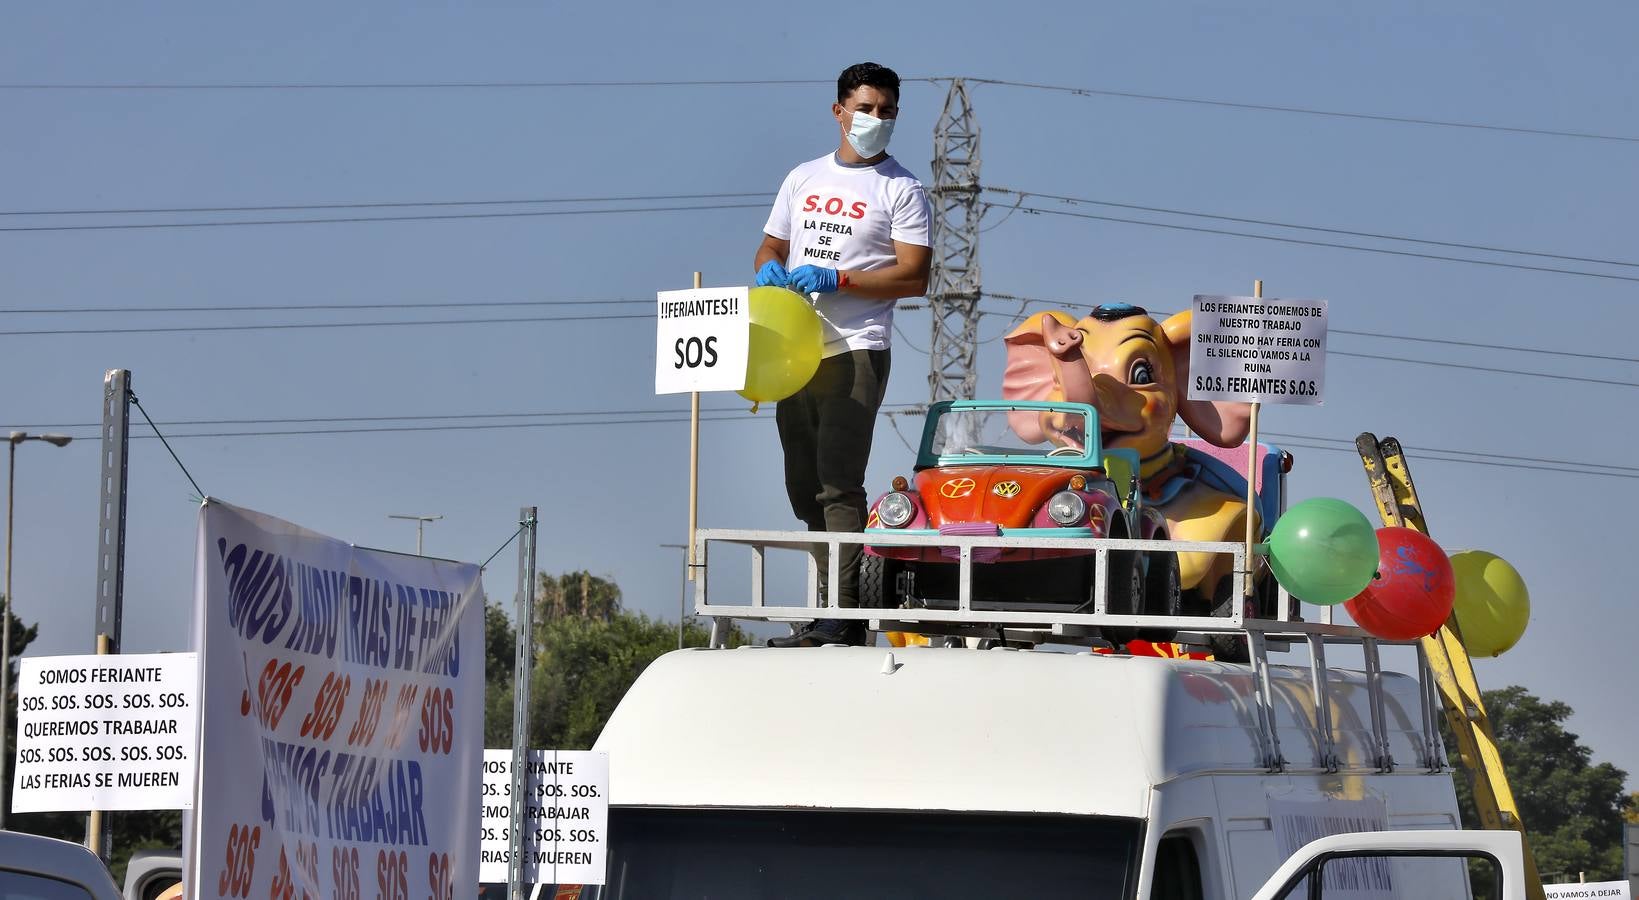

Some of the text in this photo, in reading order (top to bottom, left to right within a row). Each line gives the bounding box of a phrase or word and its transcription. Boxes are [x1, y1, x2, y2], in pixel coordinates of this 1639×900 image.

[802, 194, 867, 219] S.O.S
[804, 220, 853, 236] LA FERIA
[818, 236, 832, 246] SE
[804, 248, 841, 261] MUERE
[661, 297, 738, 318] !!FERIANTES!!
[1200, 303, 1322, 317] LOS FERIANTES COMEMOS DE
[1220, 318, 1301, 331] NUESTRO TRABAJO
[1198, 334, 1320, 348] SIN RUIDO NO HAY FERIA CON
[674, 336, 718, 369] SOS
[1207, 348, 1311, 361] EL SILENCIO VAMOS A LA
[1244, 363, 1272, 373] RUINA
[1196, 376, 1318, 396] S.O.S. FERIANTES S.O.S.
[218, 537, 294, 645] OMOS
[285, 563, 393, 669] INDURIAS
[394, 583, 418, 672] DE
[40, 668, 161, 684] SOMOS FERIANTE
[23, 693, 188, 711] SOS. SOS. SOS. SOS. SOS.
[300, 671, 351, 742] SOS
[418, 686, 454, 755] SOS
[25, 720, 176, 738] QUEREMOS TRABAJAR
[20, 746, 186, 763] SOS. SOS. SOS. SOS. SOS.
[510, 761, 573, 775] RIANTE
[21, 772, 178, 789] LAS FERIAS SE MUEREN
[537, 784, 567, 797] SOS.
[571, 784, 601, 798] SOS.
[326, 753, 428, 846] TRABAJAR
[535, 829, 565, 841] SOS.
[569, 829, 599, 842] SOS.
[219, 823, 260, 899] SOS
[333, 846, 359, 900] SOS
[378, 849, 408, 900] SOS
[428, 852, 453, 900] SO
[481, 850, 510, 863] RIAS
[533, 851, 592, 864] MUEREN
